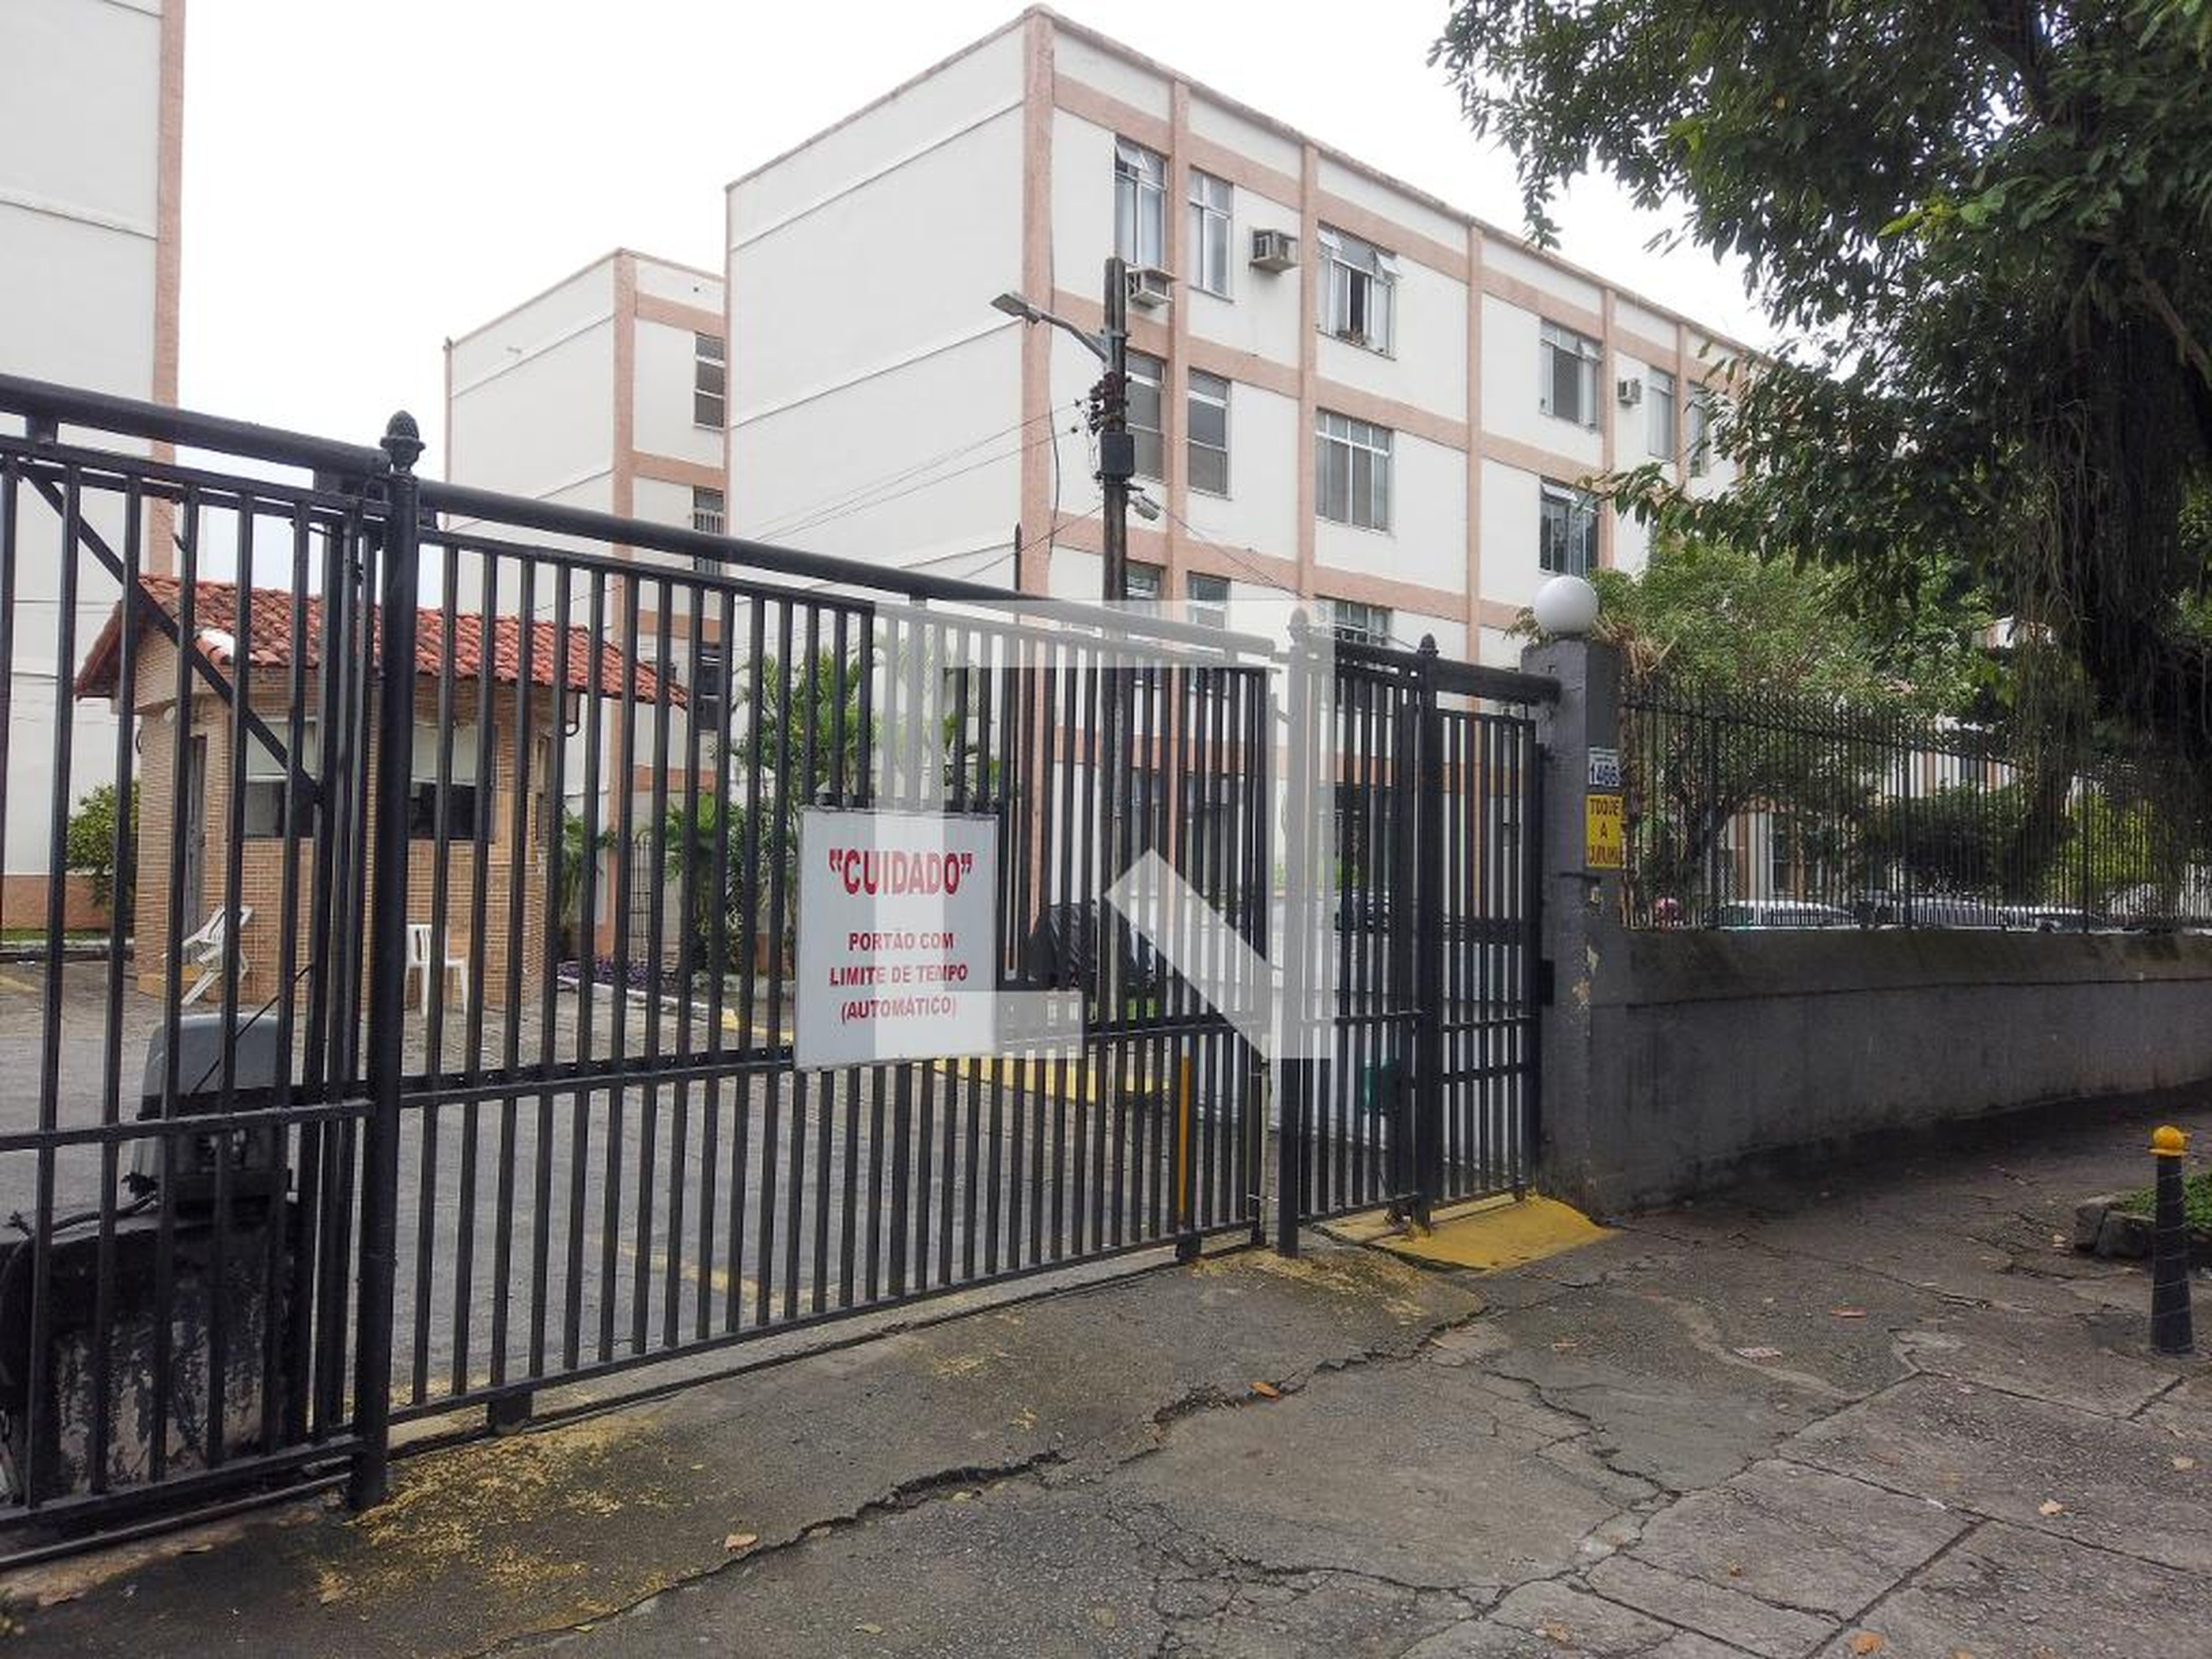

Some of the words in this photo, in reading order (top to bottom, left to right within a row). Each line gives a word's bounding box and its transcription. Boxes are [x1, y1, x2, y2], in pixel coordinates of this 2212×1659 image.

[1600, 821, 1608, 839] A
[920, 932, 953, 950] COM
[829, 966, 885, 986] LIMITE
[891, 965, 911, 983] DE
[916, 964, 968, 983] TEMPO
